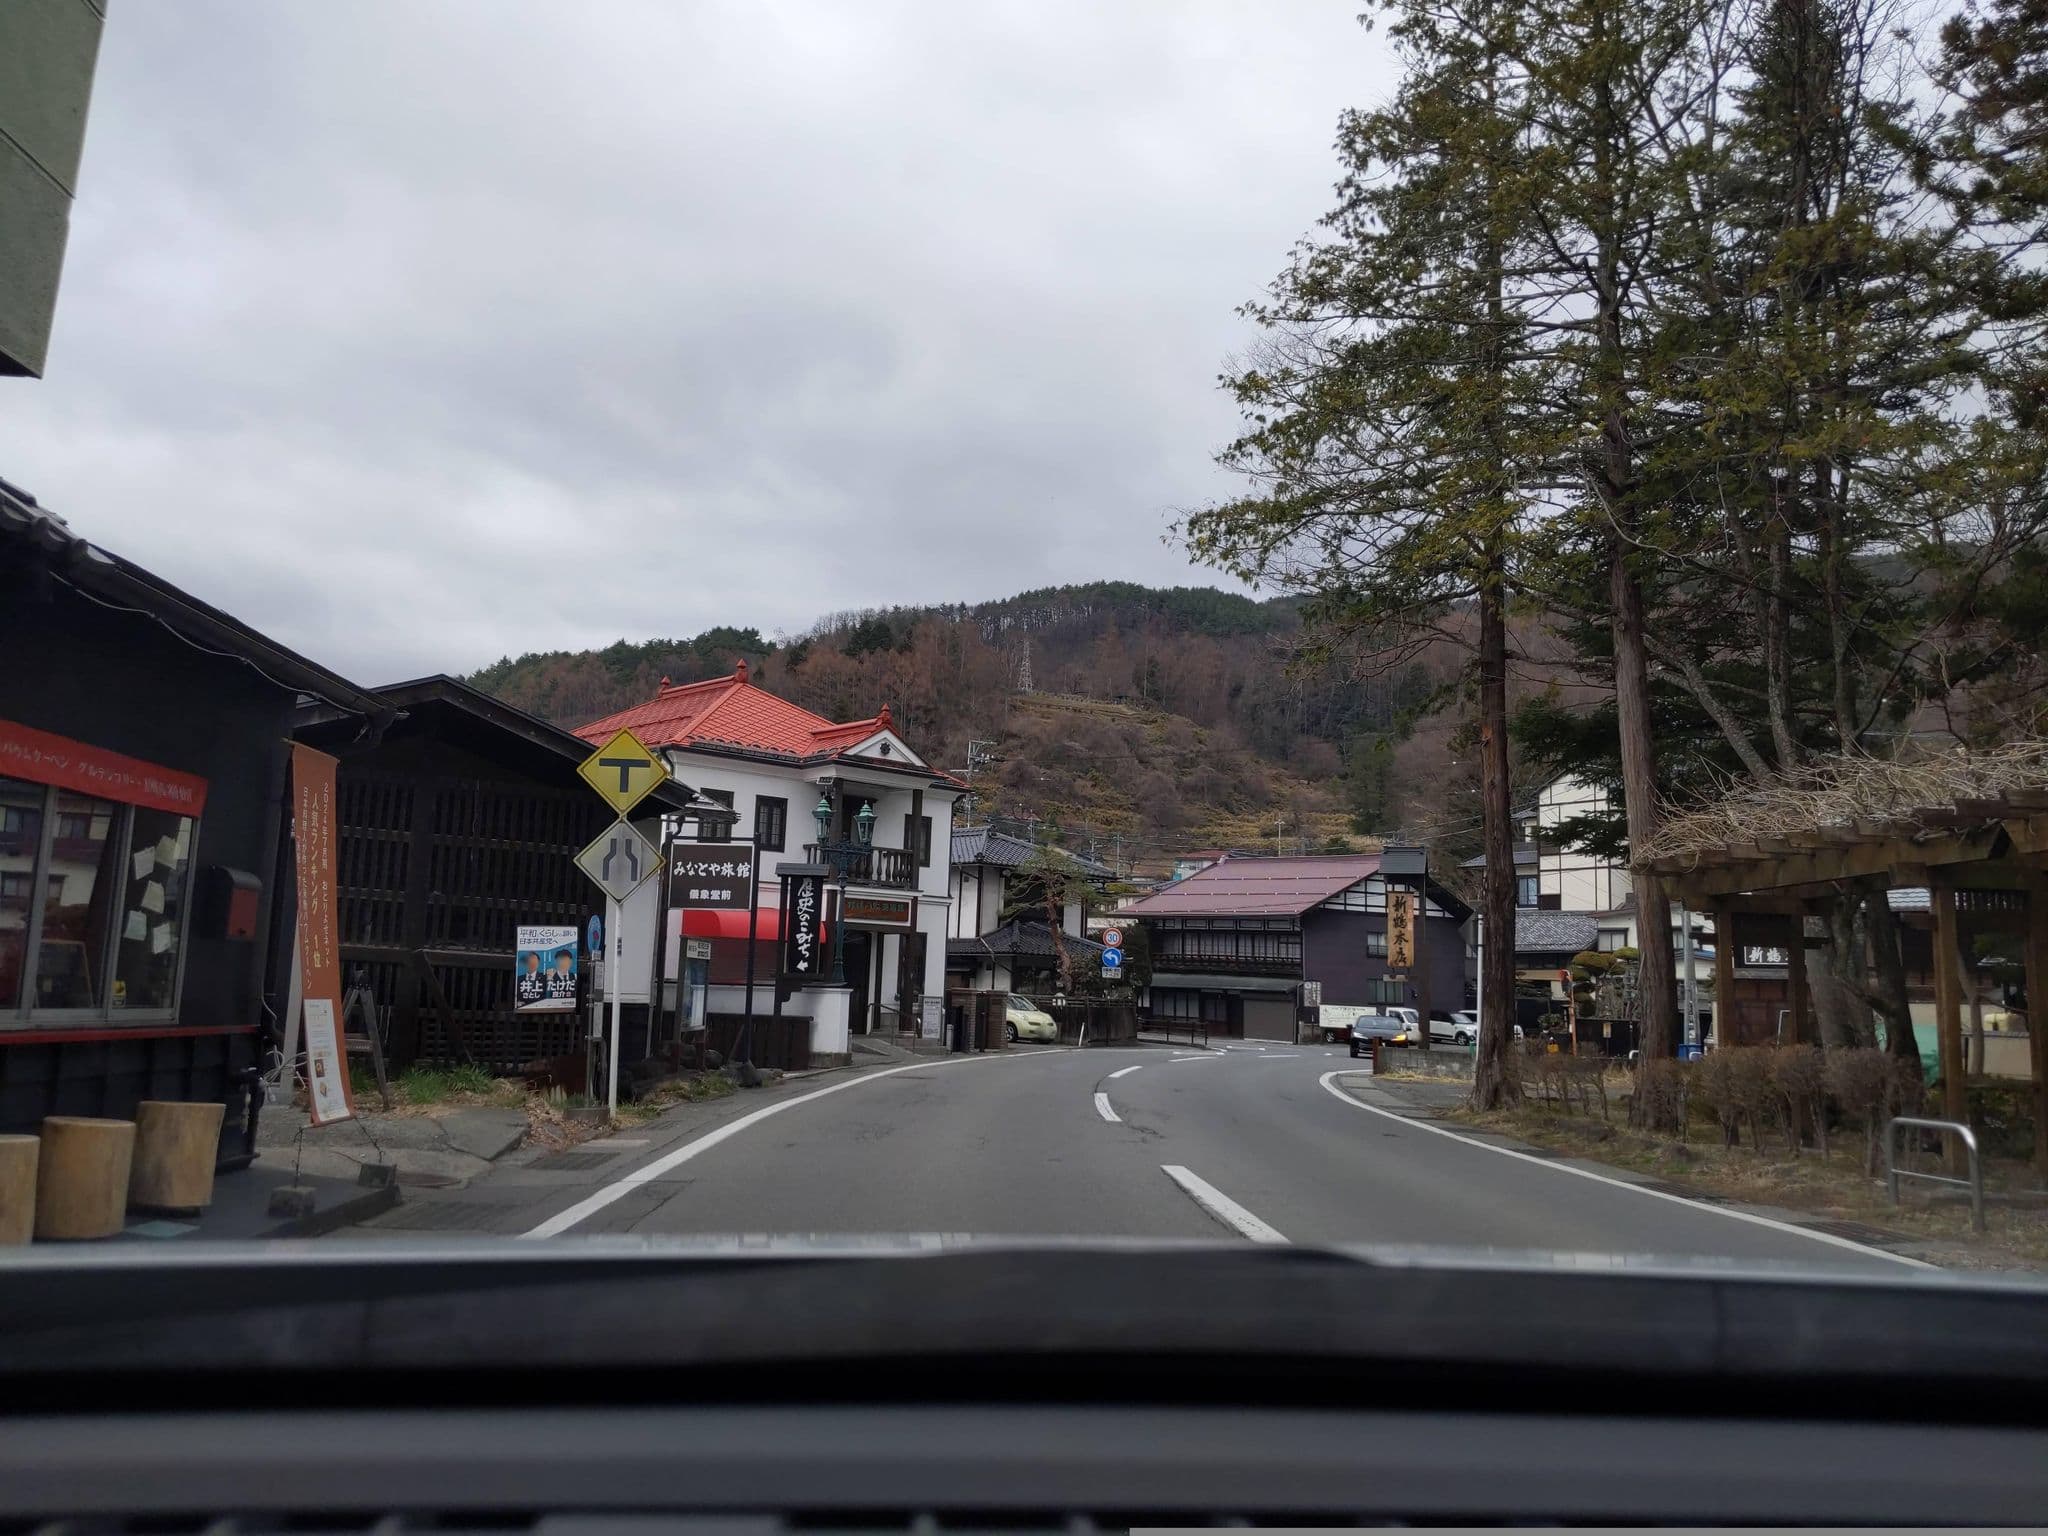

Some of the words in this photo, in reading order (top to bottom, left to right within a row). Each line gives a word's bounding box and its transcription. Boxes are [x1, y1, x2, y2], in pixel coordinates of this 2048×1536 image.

[674, 861, 751, 878] みなとや旅館
[520, 929, 537, 938] 平和
[1392, 896, 1408, 965] 新鶴本店
[1108, 934, 1118, 942] 30
[1749, 947, 1788, 962] 新鶴
[520, 981, 543, 992] 井上
[547, 980, 576, 991] たけだ
